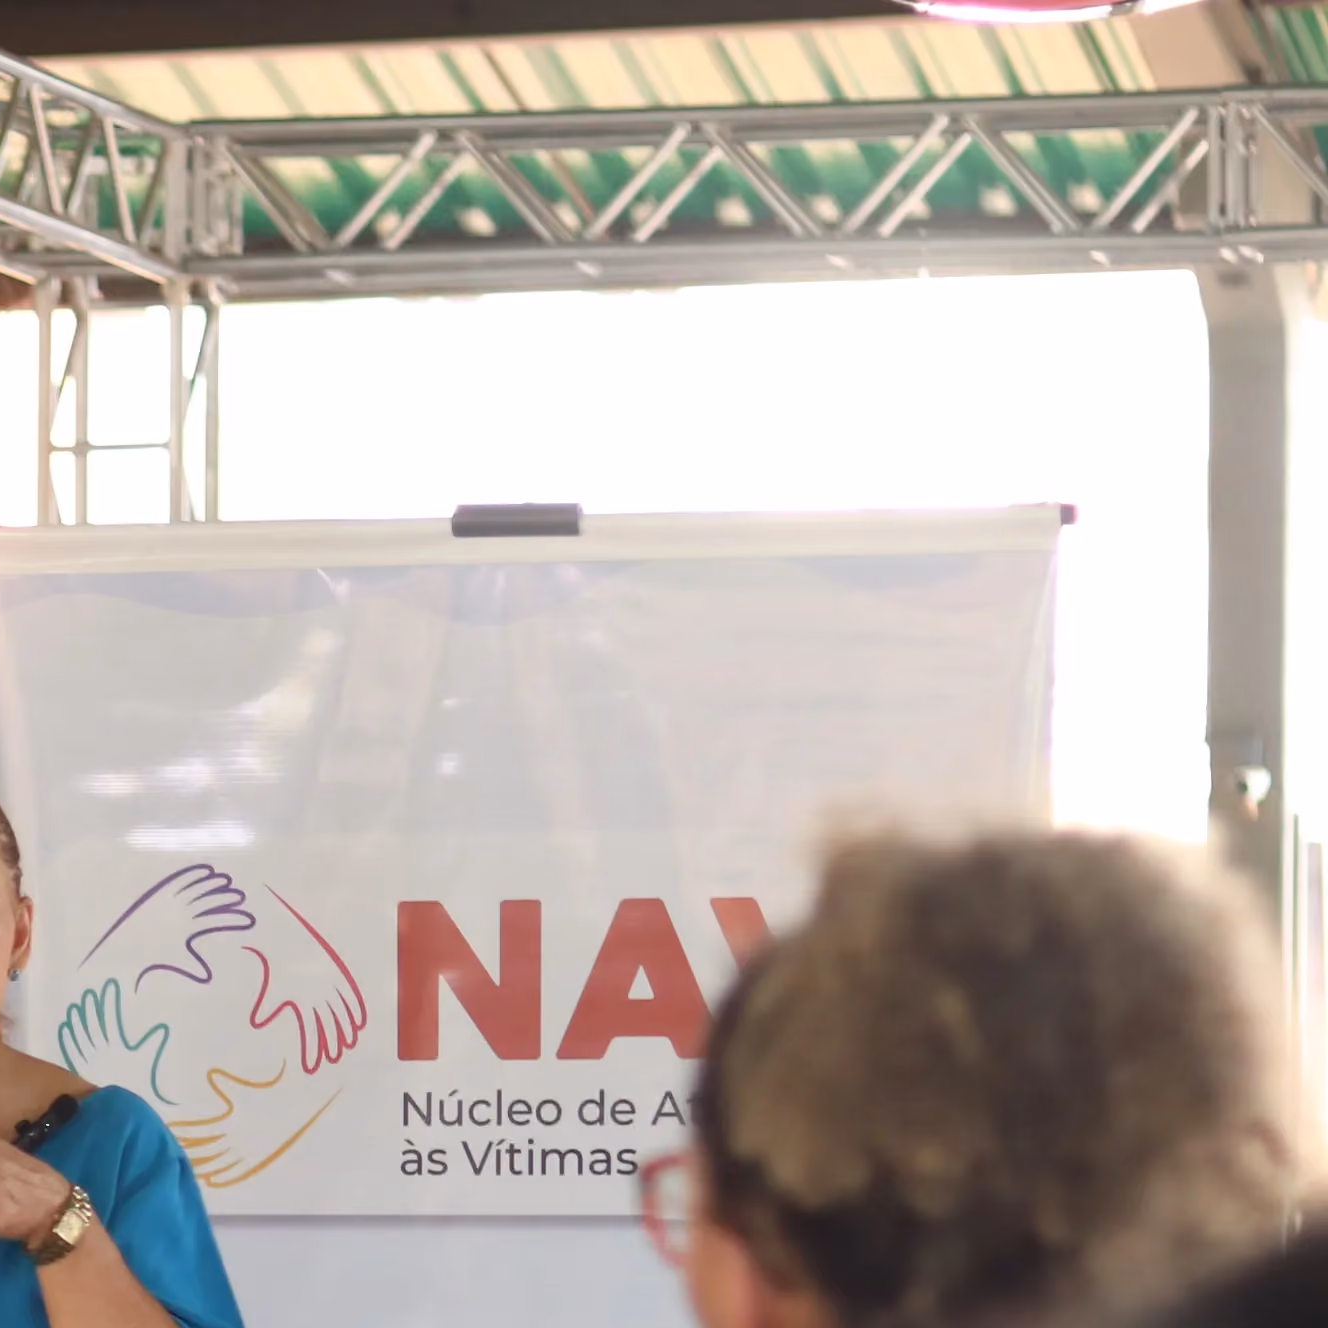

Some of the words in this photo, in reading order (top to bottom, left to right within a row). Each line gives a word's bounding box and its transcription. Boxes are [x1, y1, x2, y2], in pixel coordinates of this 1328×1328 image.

[403, 1089, 562, 1126] Núcleo
[577, 1090, 636, 1126] de
[400, 1142, 448, 1175] às
[461, 1139, 639, 1175] Vítimas
